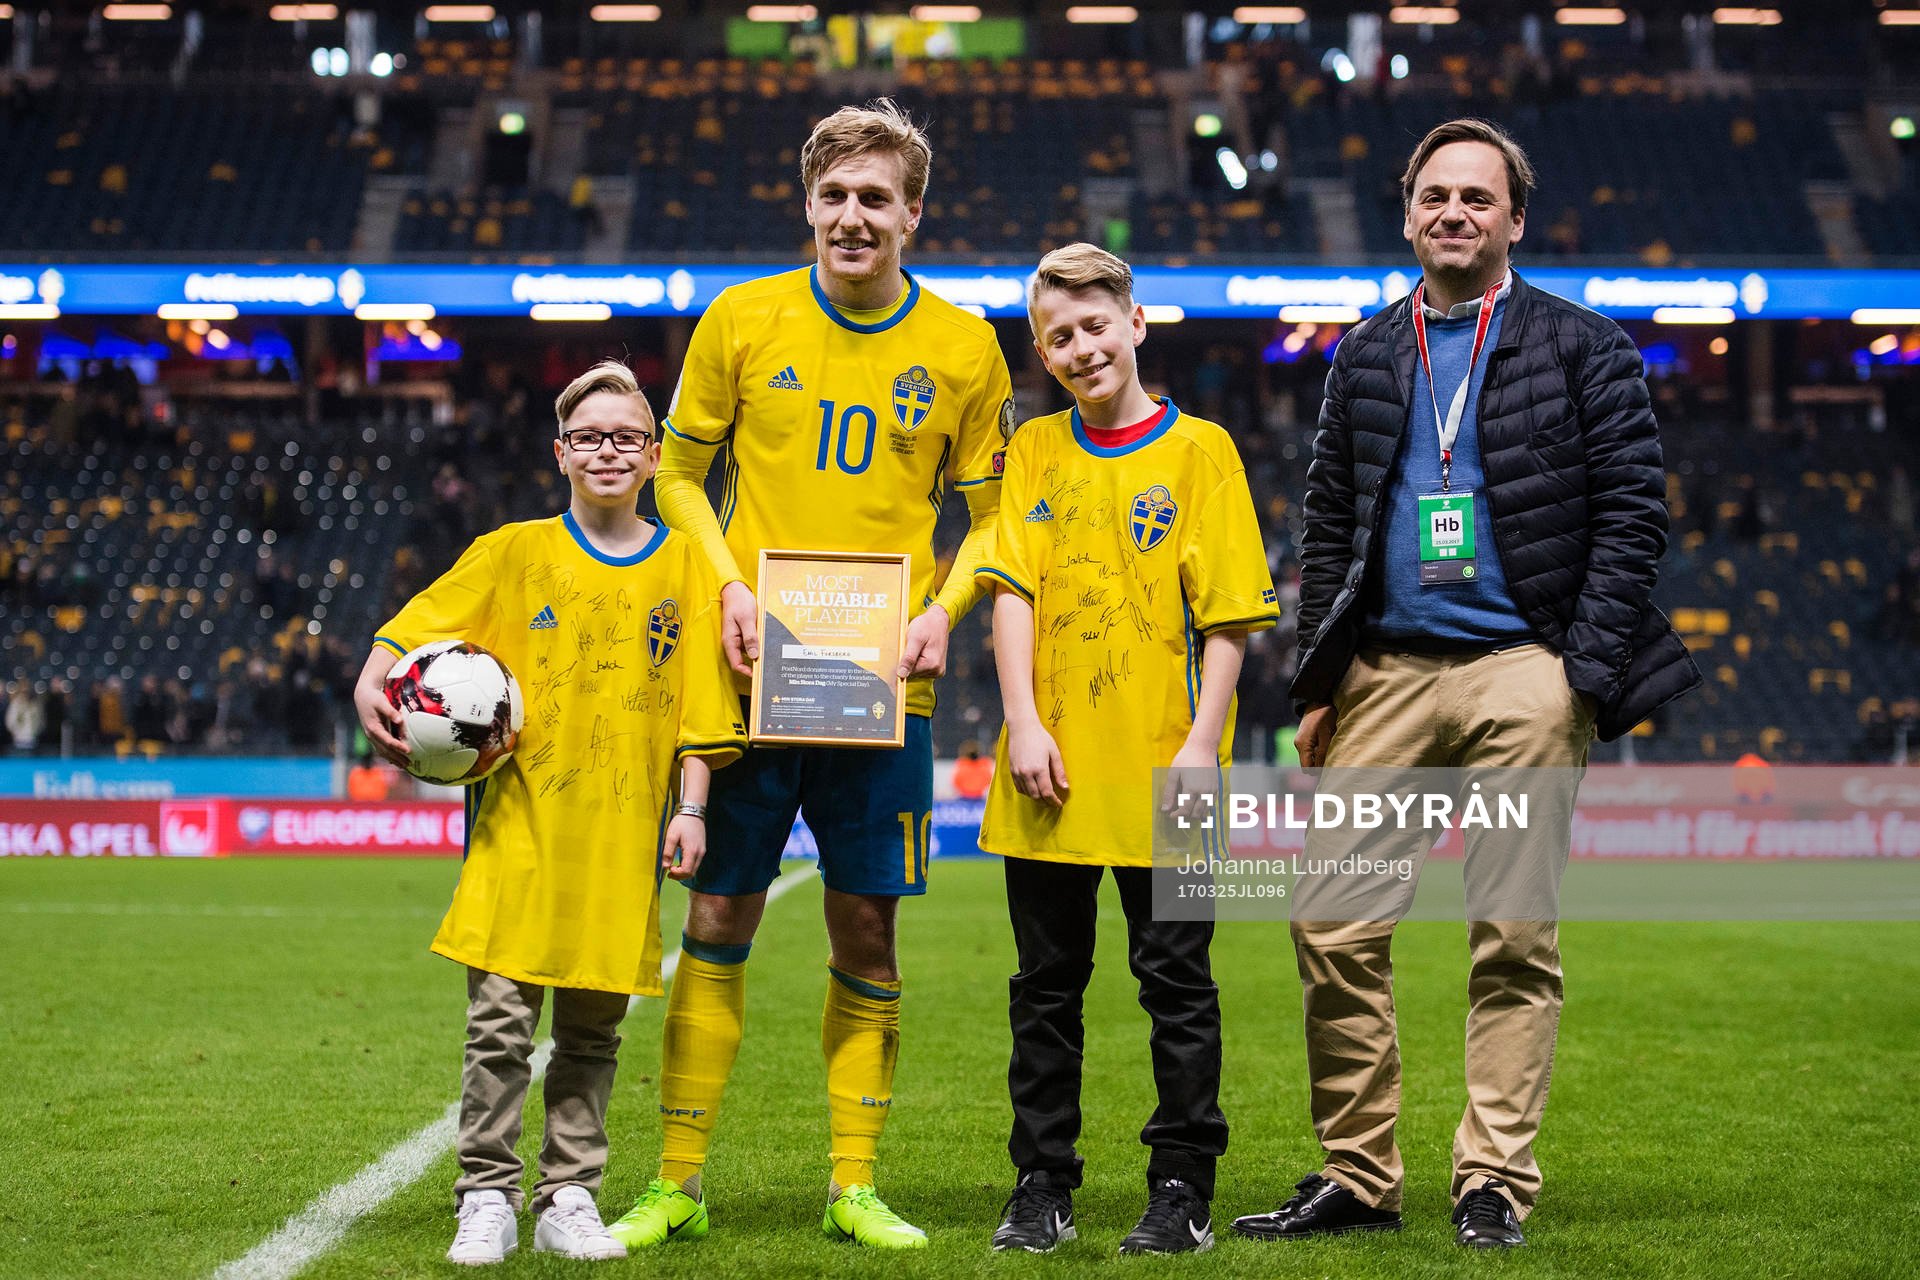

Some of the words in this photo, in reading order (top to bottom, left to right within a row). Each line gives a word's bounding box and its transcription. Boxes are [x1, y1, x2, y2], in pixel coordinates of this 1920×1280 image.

[768, 380, 803, 391] adidas
[900, 383, 929, 394] SVERIGE
[816, 399, 877, 475] 10
[1024, 512, 1055, 522] adidas
[1435, 517, 1460, 533] Hb
[805, 574, 863, 591] MOST
[779, 590, 888, 609] VALUABLE
[529, 619, 559, 630] adida
[795, 607, 870, 625] PLAYER
[273, 809, 442, 846] EUROPEAN
[69, 822, 157, 857] SPEL
